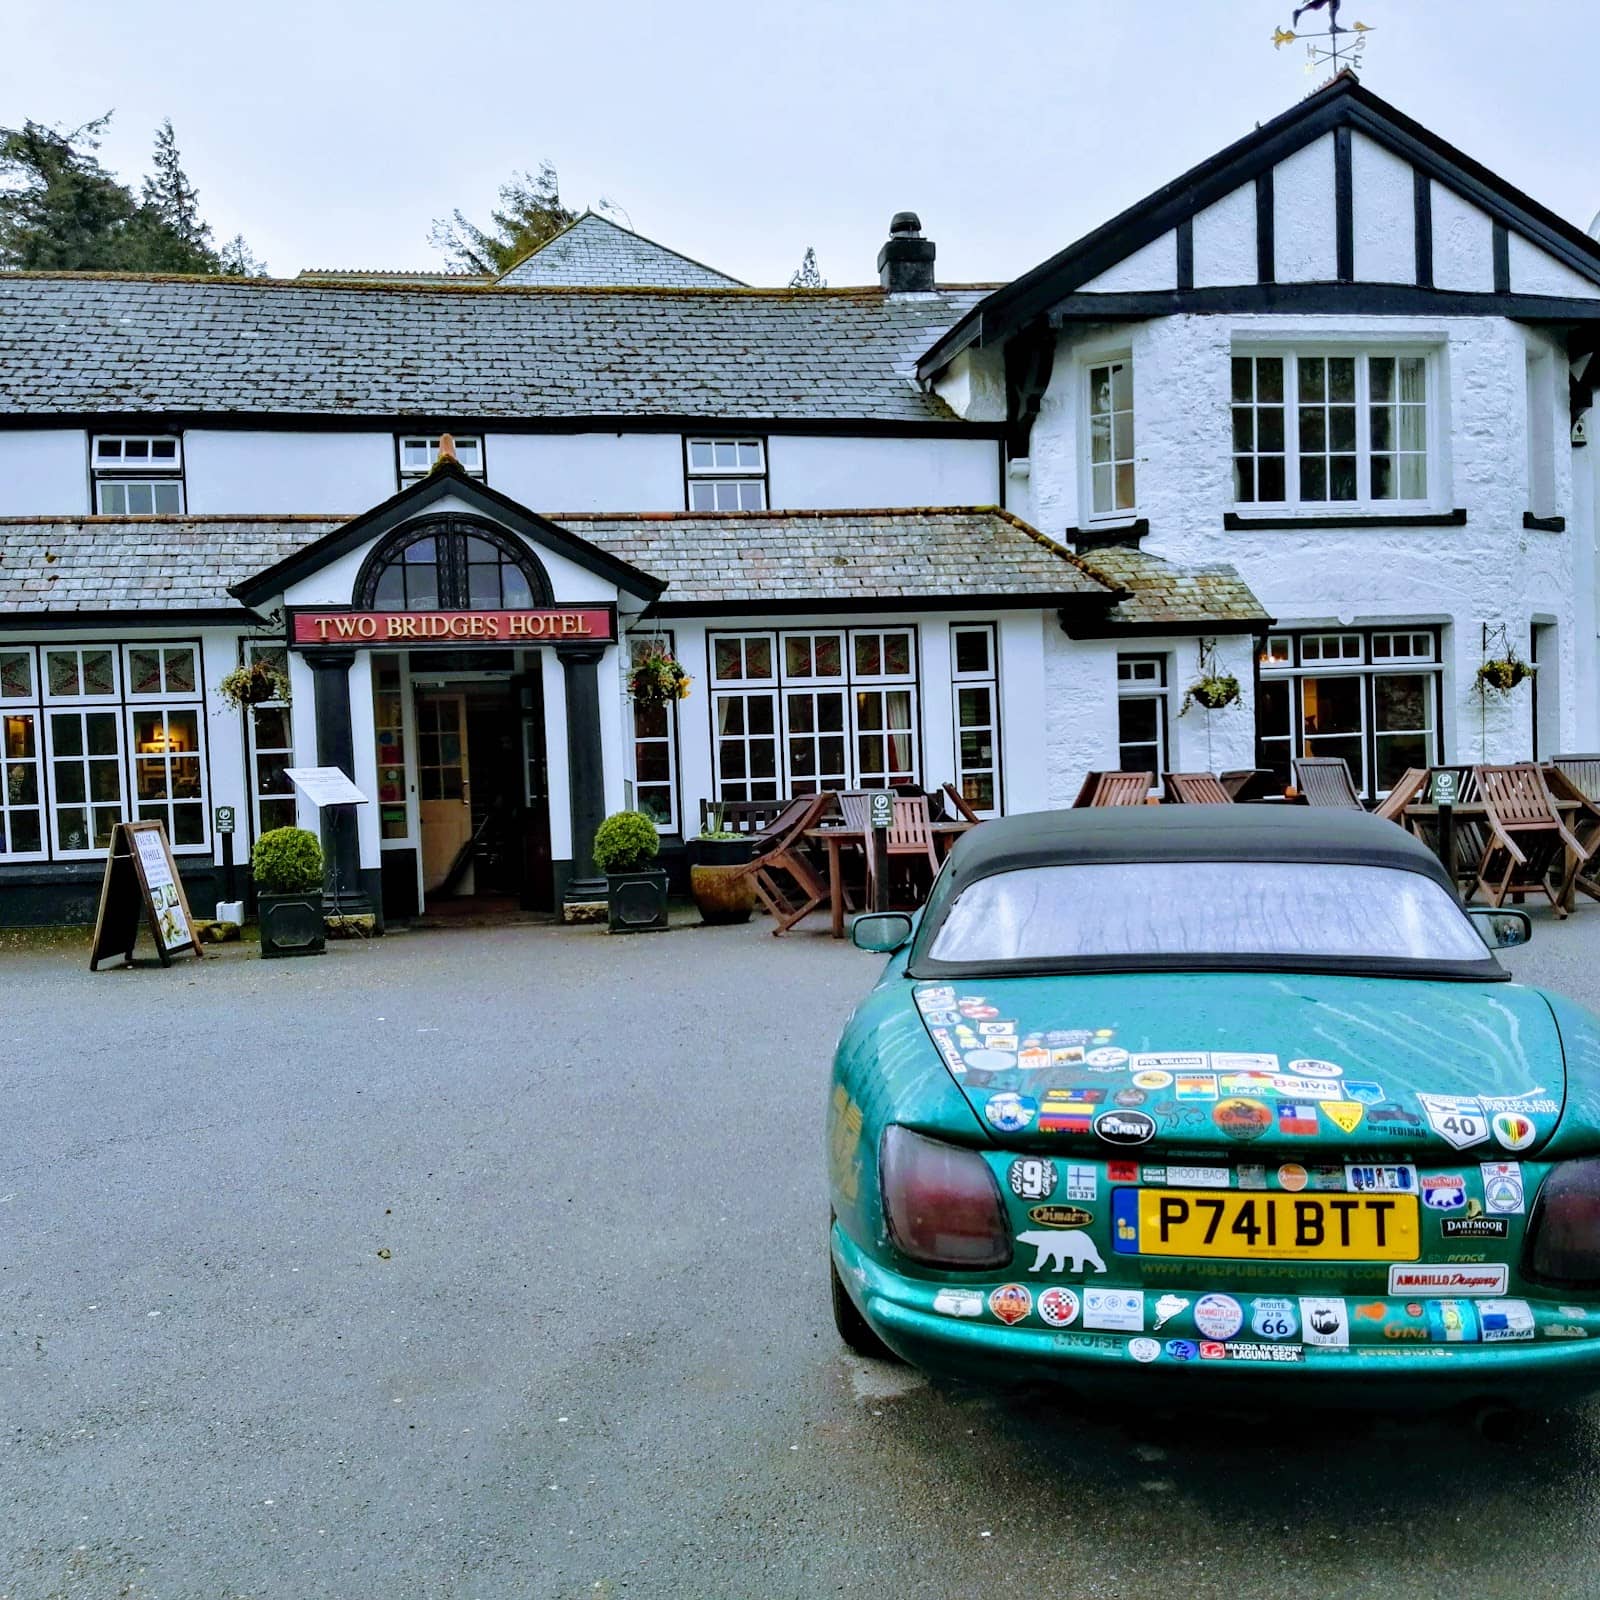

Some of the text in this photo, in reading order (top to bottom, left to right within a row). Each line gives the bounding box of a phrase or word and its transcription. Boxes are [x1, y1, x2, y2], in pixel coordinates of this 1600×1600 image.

[315, 614, 592, 639] TWO BRIDGES HOTEL
[1274, 1079, 1338, 1091] Bolivia
[1443, 1116, 1476, 1136] 40
[1022, 1160, 1042, 1195] 9
[1167, 1168, 1201, 1179] SHOOT
[1203, 1169, 1228, 1180] BACK
[1351, 1166, 1411, 1190] QUITO
[1159, 1197, 1396, 1247] P741 BTT
[1447, 1220, 1502, 1232] DARTMOOR
[1396, 1274, 1450, 1286] AMARILLO
[1262, 1319, 1288, 1335] 66
[1484, 1329, 1533, 1339] PANAMA
[1225, 1343, 1302, 1352] MAZDA RACEWAY
[1233, 1350, 1298, 1361] LAGUNA SECA
